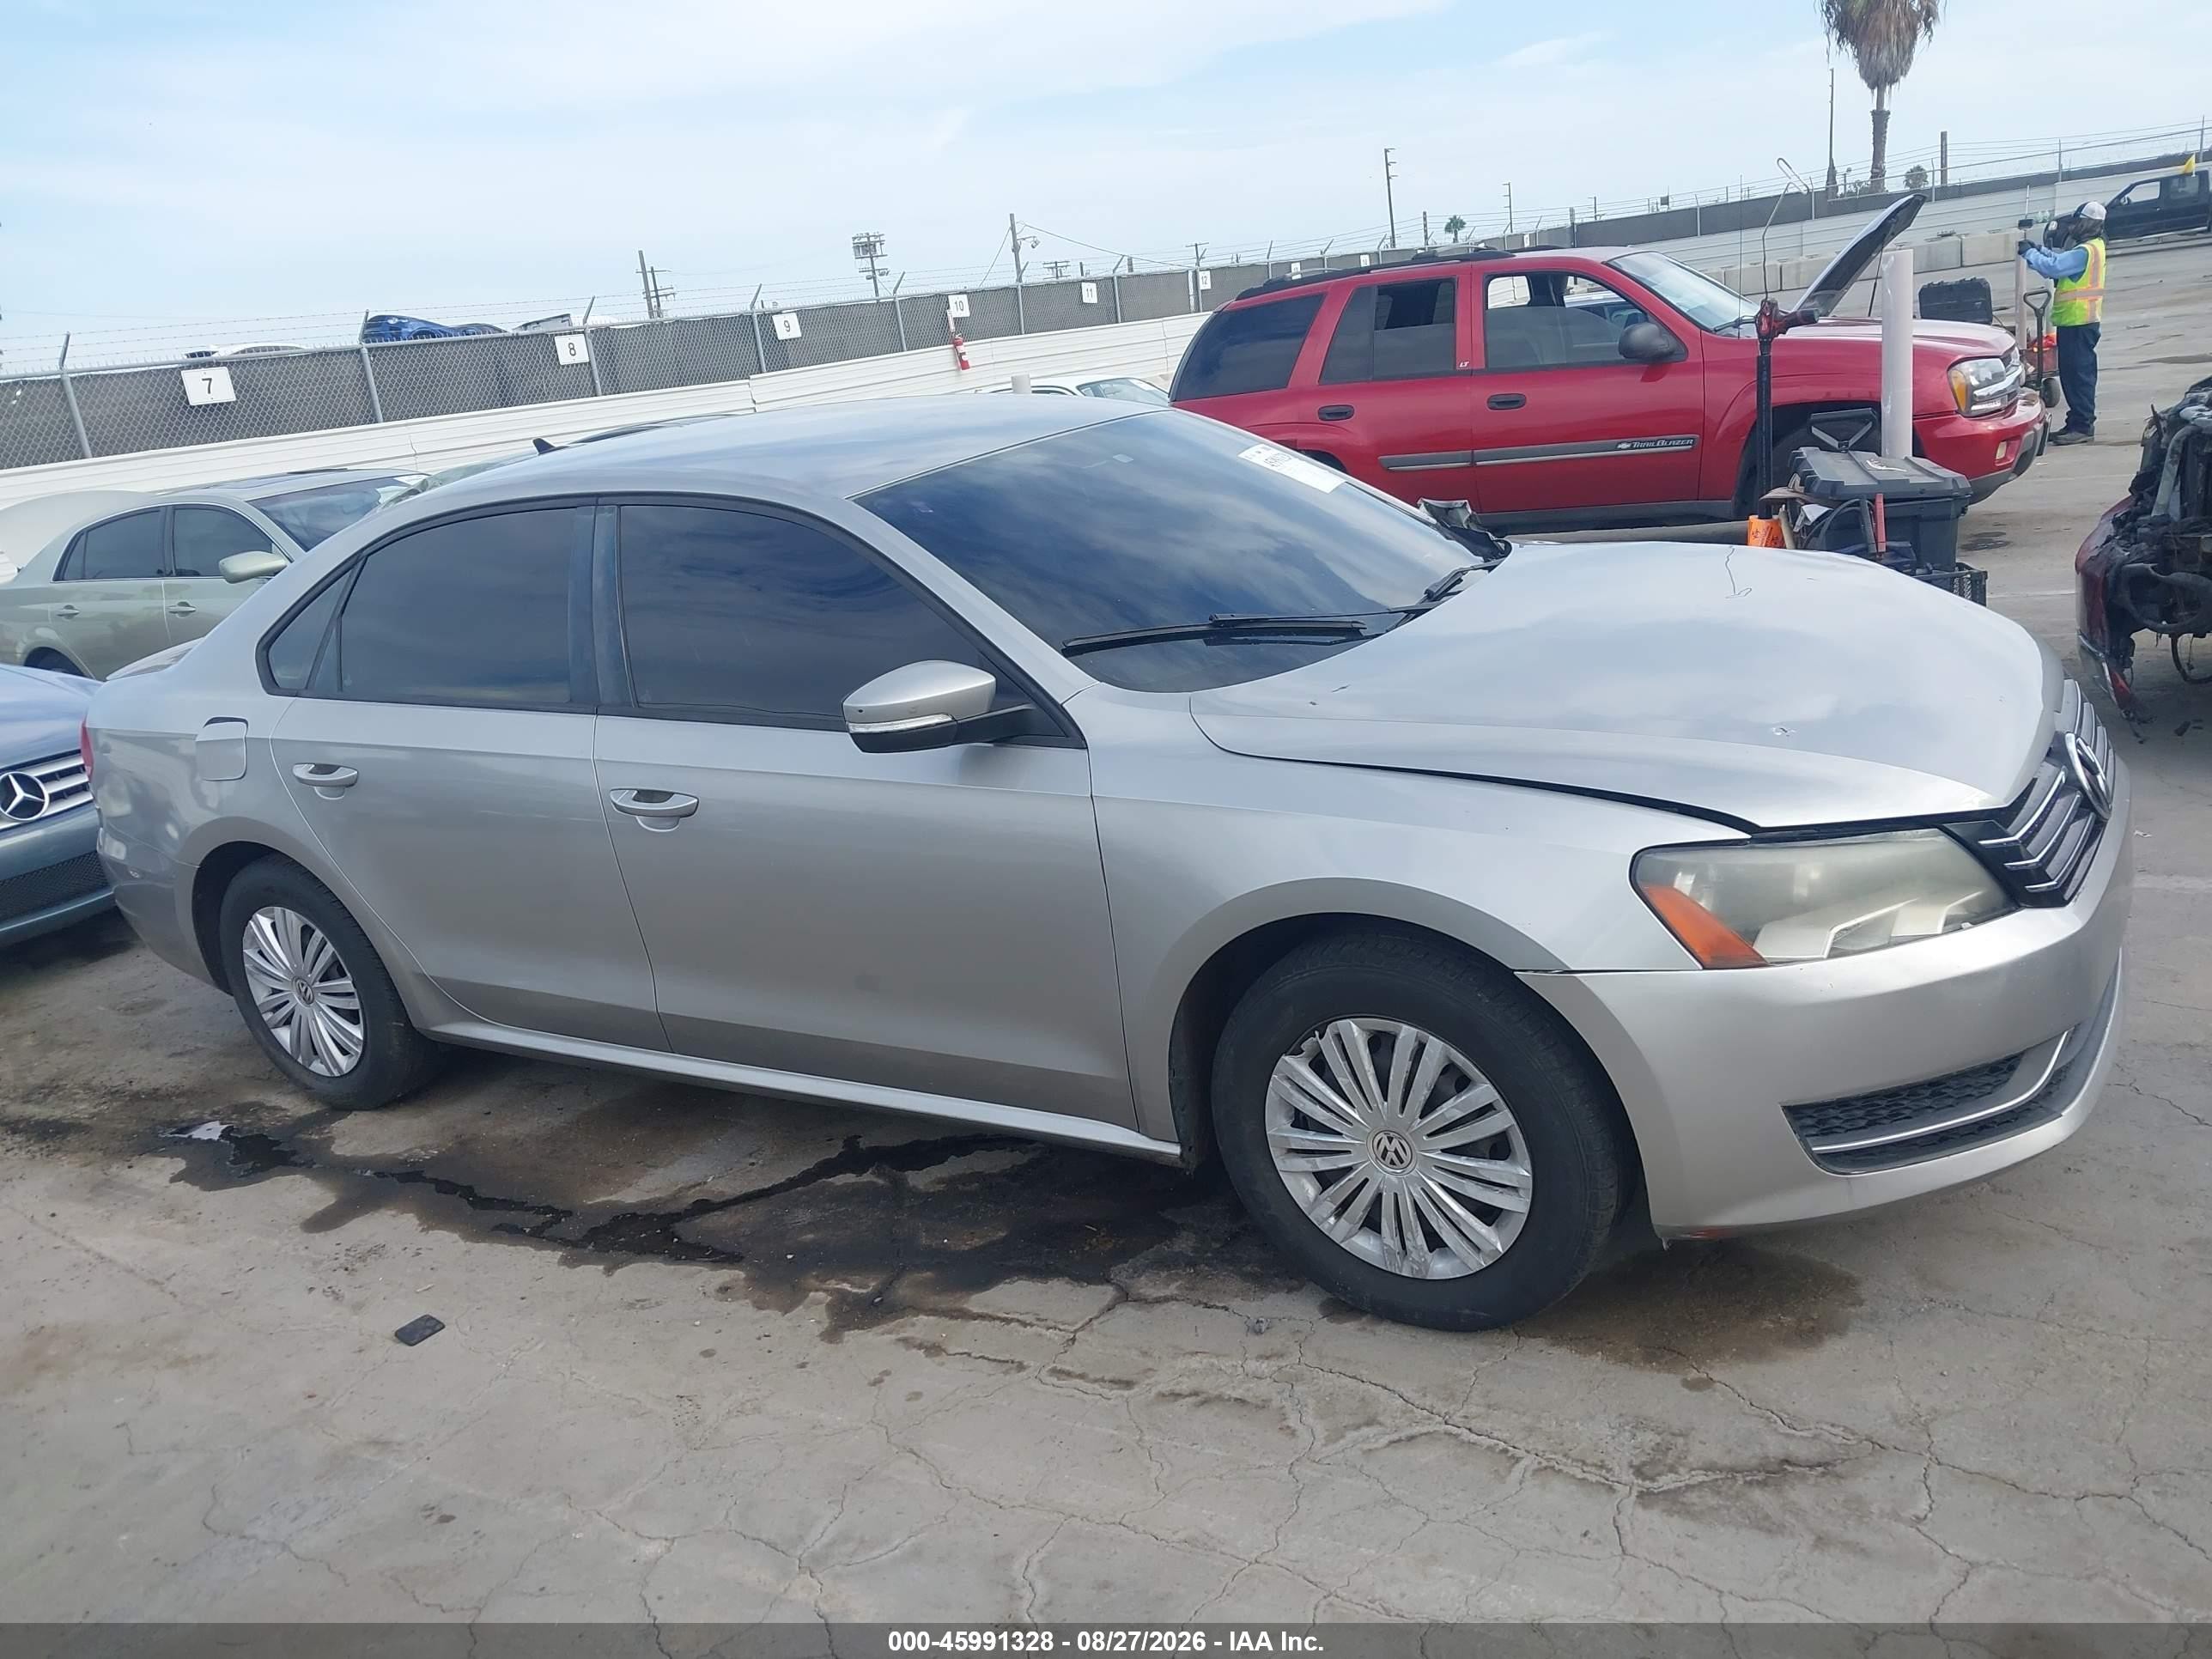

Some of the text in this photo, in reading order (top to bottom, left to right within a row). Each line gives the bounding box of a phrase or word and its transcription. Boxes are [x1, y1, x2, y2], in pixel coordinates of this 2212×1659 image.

[1085, 288, 1093, 298] 11
[955, 301, 964, 311] 10
[783, 319, 791, 332] 9
[568, 342, 577, 356] 8
[202, 378, 213, 394] 7
